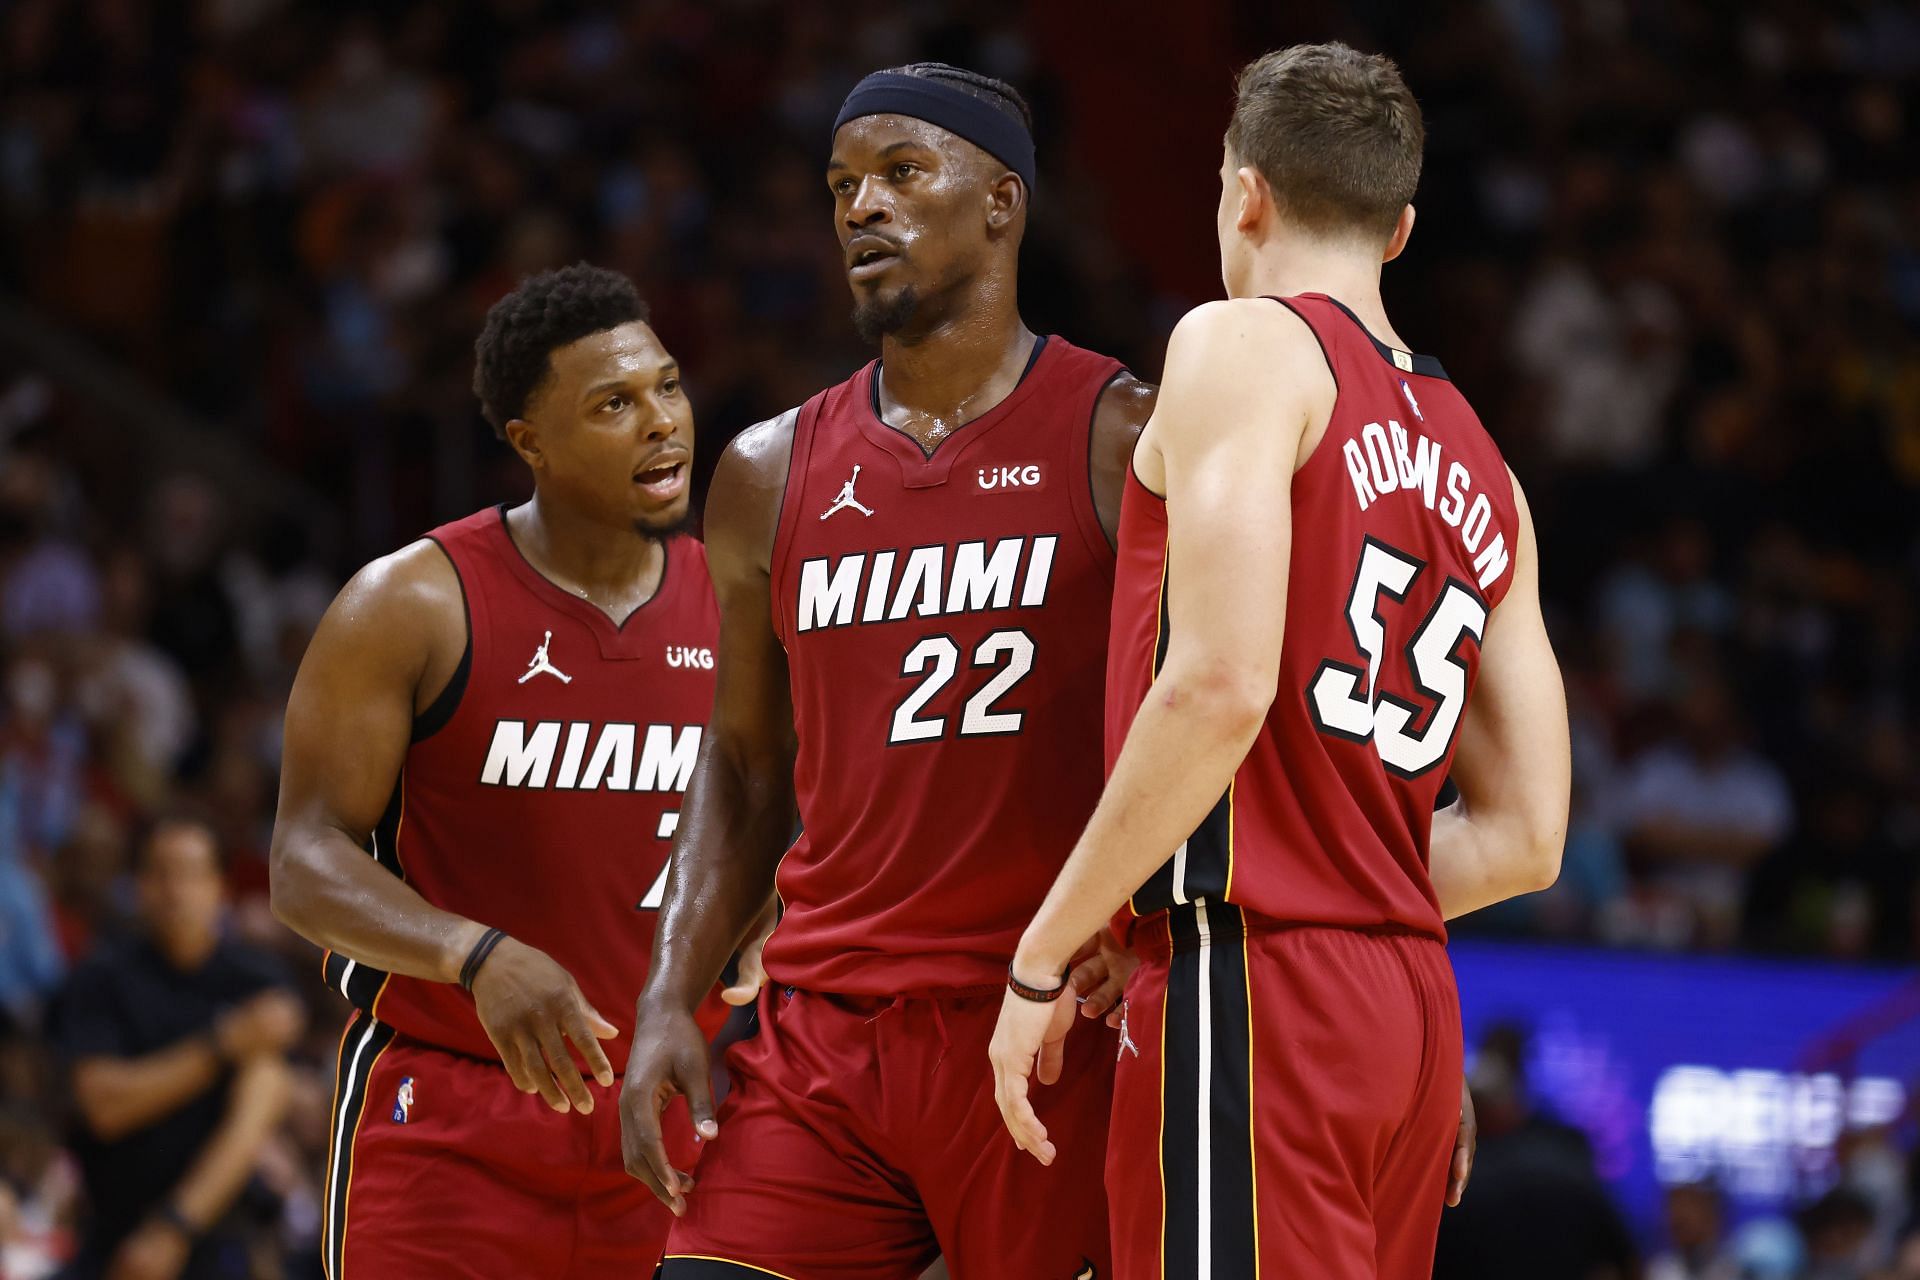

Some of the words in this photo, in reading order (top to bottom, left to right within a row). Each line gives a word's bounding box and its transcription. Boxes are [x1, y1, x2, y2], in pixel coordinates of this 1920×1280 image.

[1343, 420, 1508, 590] ROBNSON
[797, 534, 1057, 632] MIAMI
[887, 627, 1036, 746] 22
[1305, 534, 1490, 780] 55
[480, 719, 703, 793] MIAM
